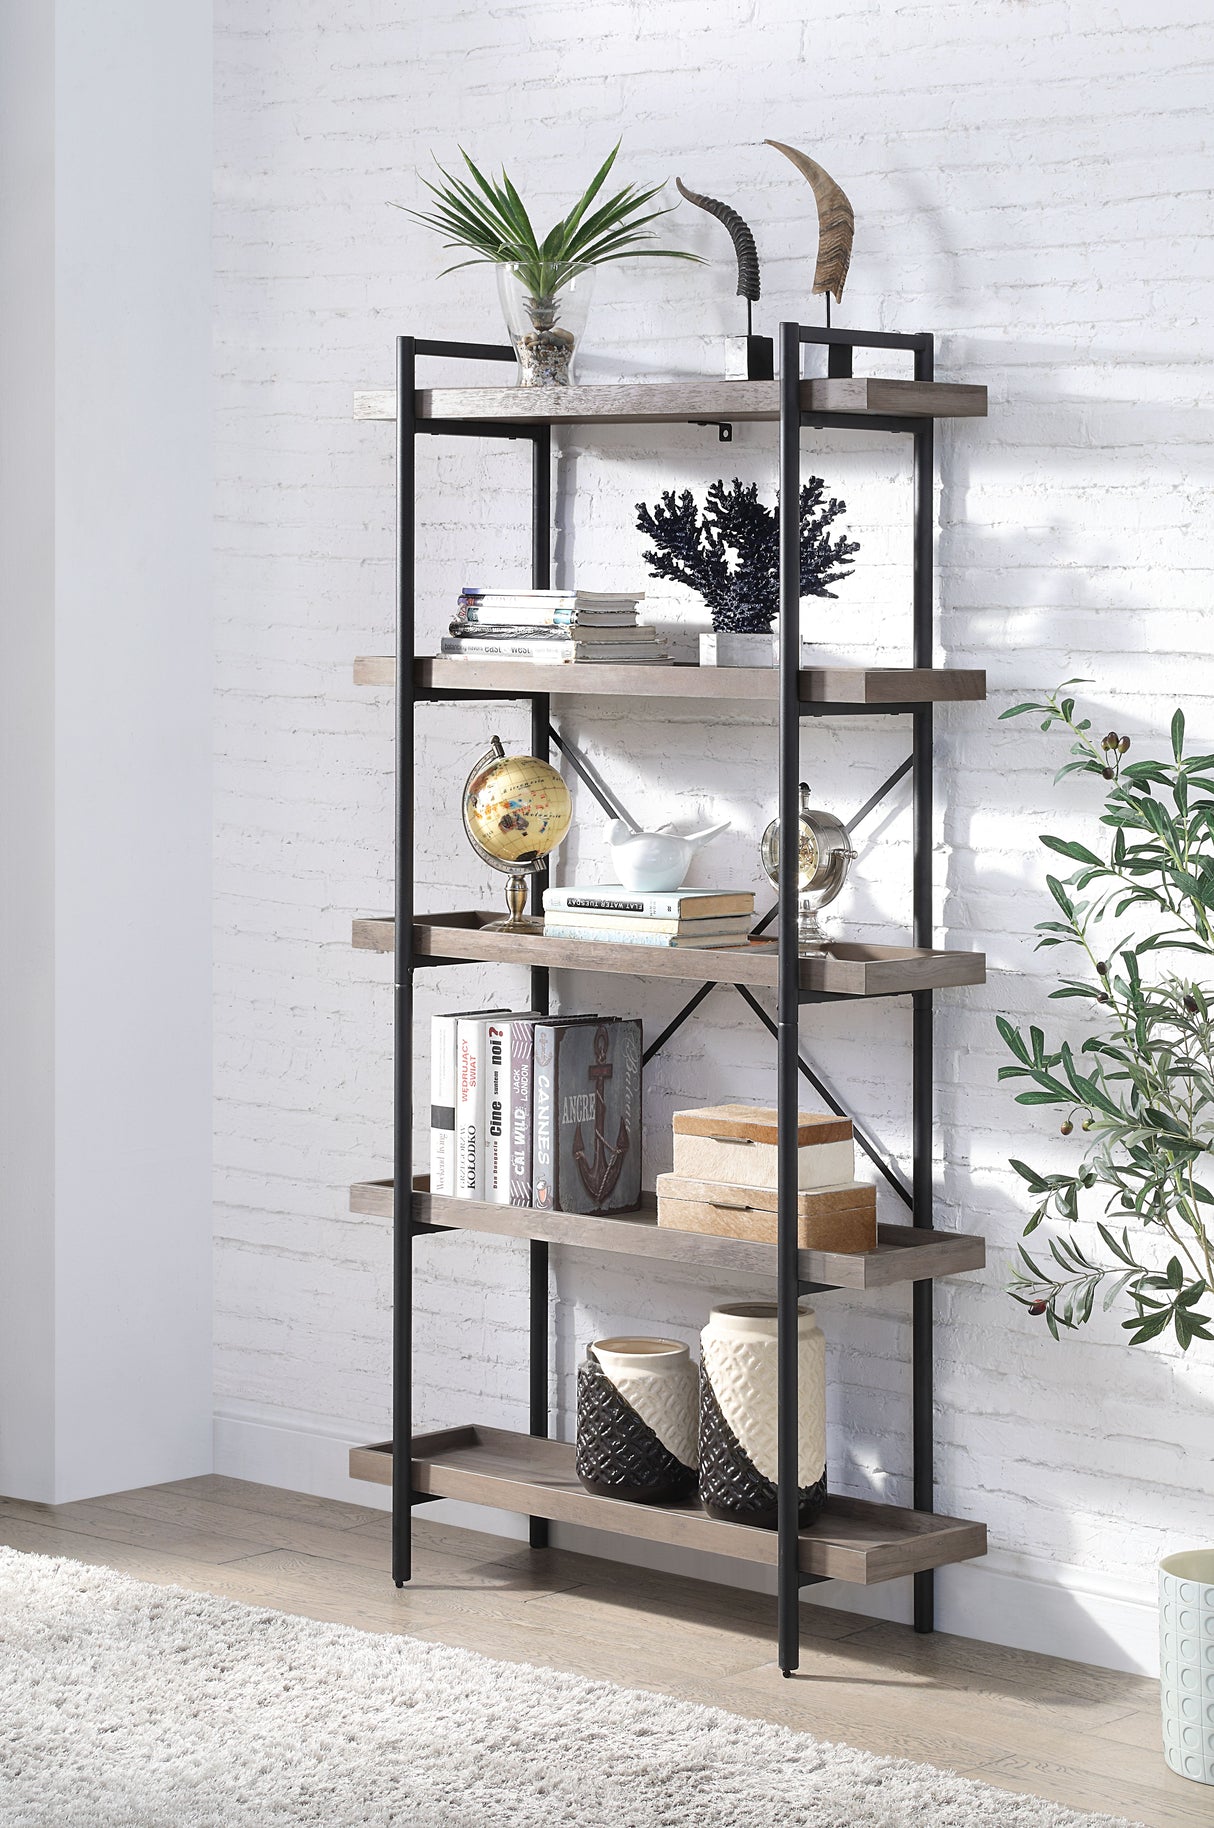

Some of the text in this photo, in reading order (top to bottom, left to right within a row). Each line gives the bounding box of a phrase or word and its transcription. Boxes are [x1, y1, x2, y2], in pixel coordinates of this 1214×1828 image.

[484, 644, 502, 653] east
[511, 645, 531, 654] west
[567, 898, 599, 907] TUESDAY
[601, 900, 624, 909] WATER
[625, 902, 643, 910] FLAT
[512, 1069, 521, 1094] JACK
[520, 1064, 529, 1102] LONDON
[490, 1101, 502, 1137] Cine
[538, 1075, 550, 1165] CANNES
[561, 1092, 596, 1125] ANCRE
[513, 1106, 527, 1145] WILD
[467, 1125, 476, 1190] KOŁODKO
